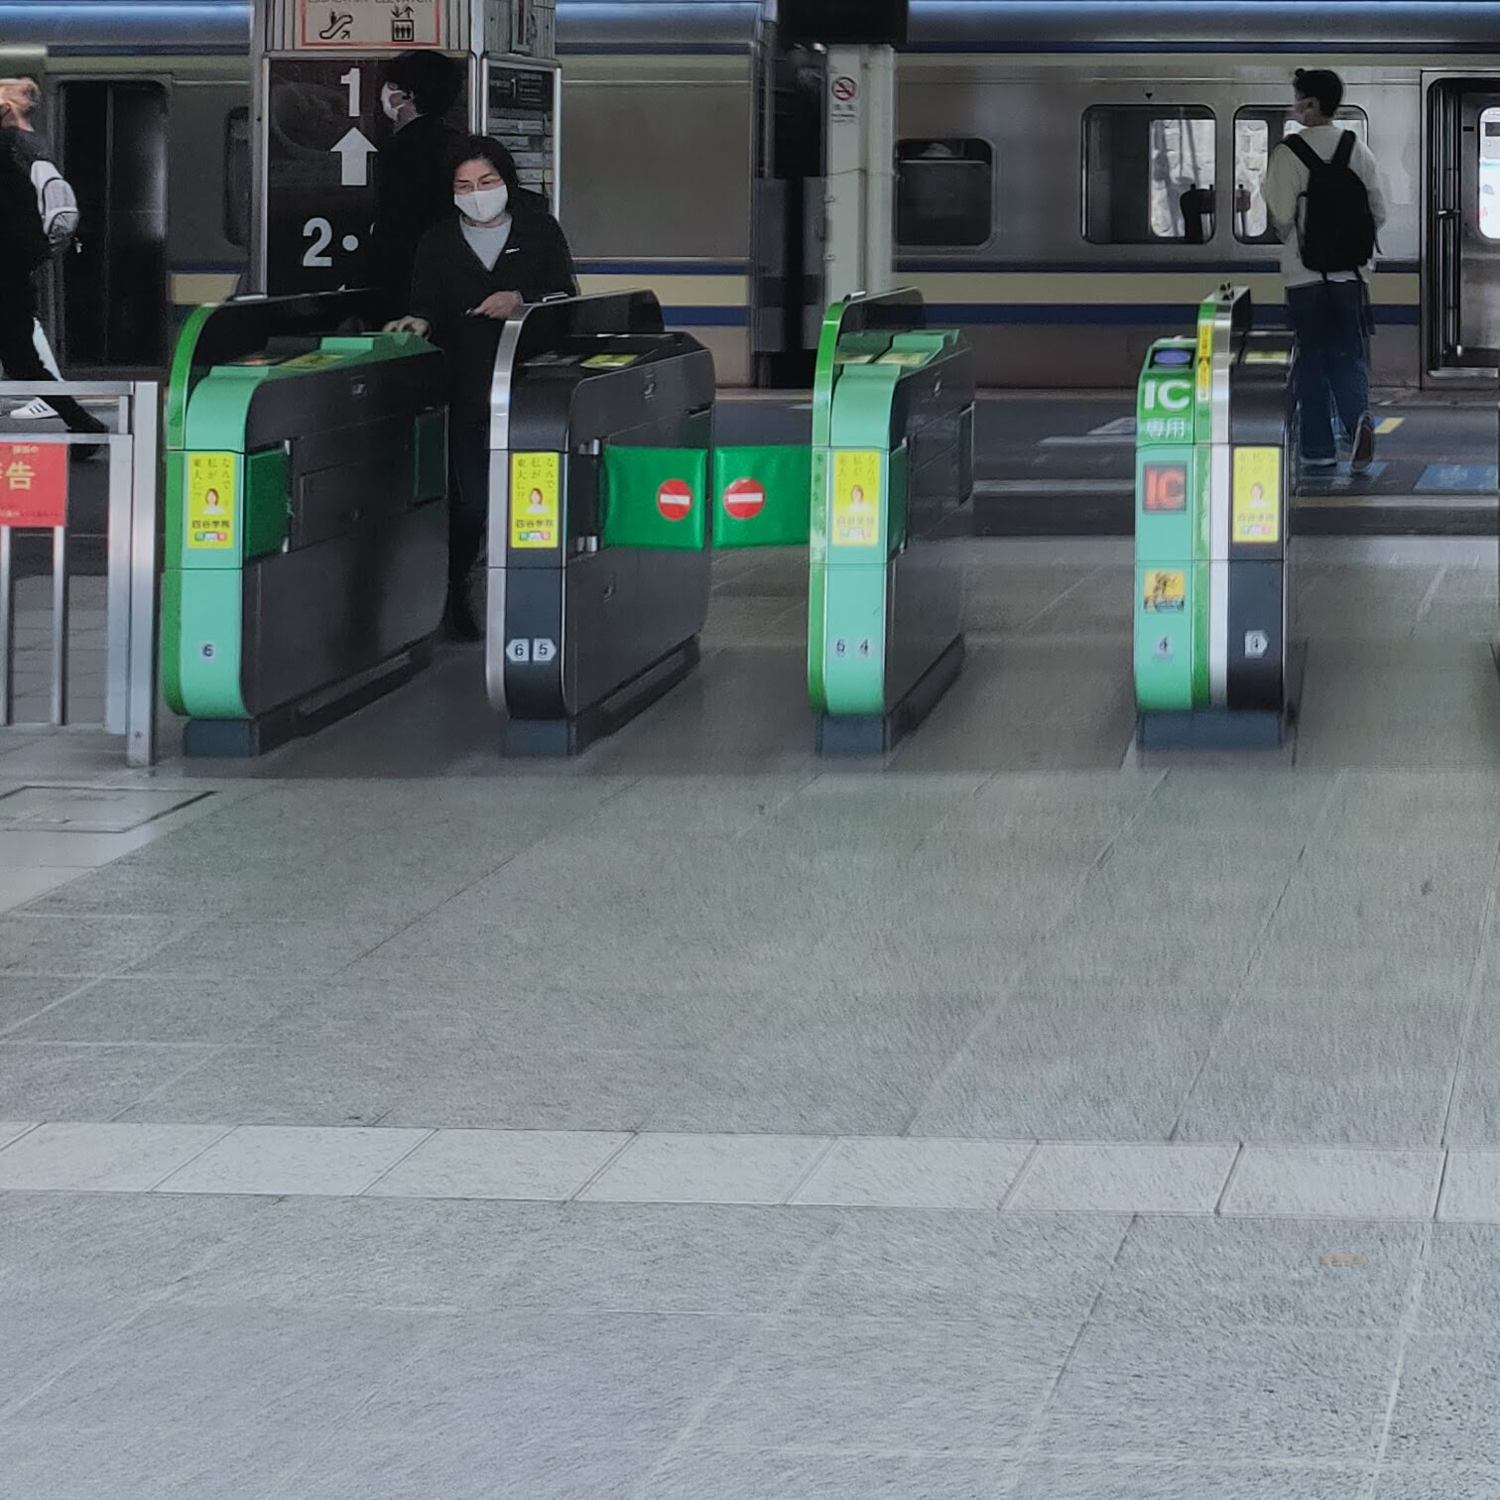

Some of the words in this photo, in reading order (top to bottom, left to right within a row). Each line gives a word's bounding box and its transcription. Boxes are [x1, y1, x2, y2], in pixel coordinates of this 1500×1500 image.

[340, 67, 361, 117] 1
[1144, 380, 1191, 412] IC
[1146, 418, 1185, 439] 専用
[0, 461, 36, 491] 告
[1146, 469, 1185, 510] IC
[202, 644, 214, 657] 6
[515, 643, 524, 656] 6
[539, 643, 548, 656] 5
